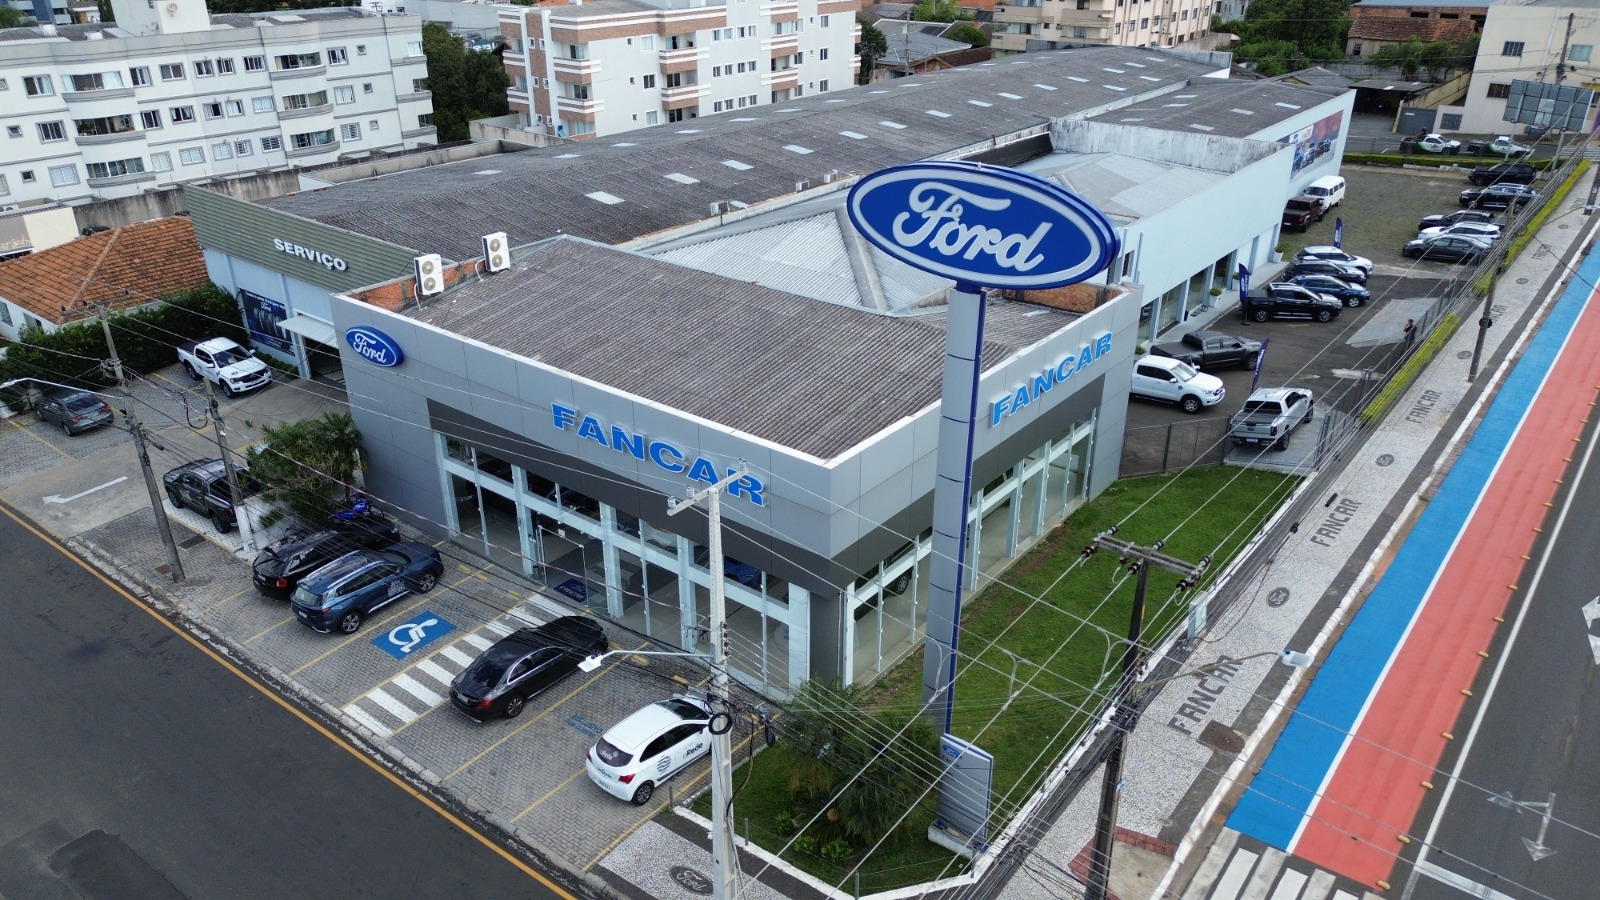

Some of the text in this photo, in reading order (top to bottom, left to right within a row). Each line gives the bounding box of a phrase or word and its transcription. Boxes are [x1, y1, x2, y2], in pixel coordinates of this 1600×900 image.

[892, 181, 1053, 272] Ford
[274, 238, 347, 271] SERVIÇO
[353, 332, 386, 363] Ford
[992, 331, 1112, 427] FANCAR
[1405, 389, 1442, 424] FANCAR
[551, 402, 766, 507] FANCAR
[1310, 498, 1363, 547] FANCAR
[1167, 655, 1244, 735] FANCAR
[676, 870, 707, 891] Ford
